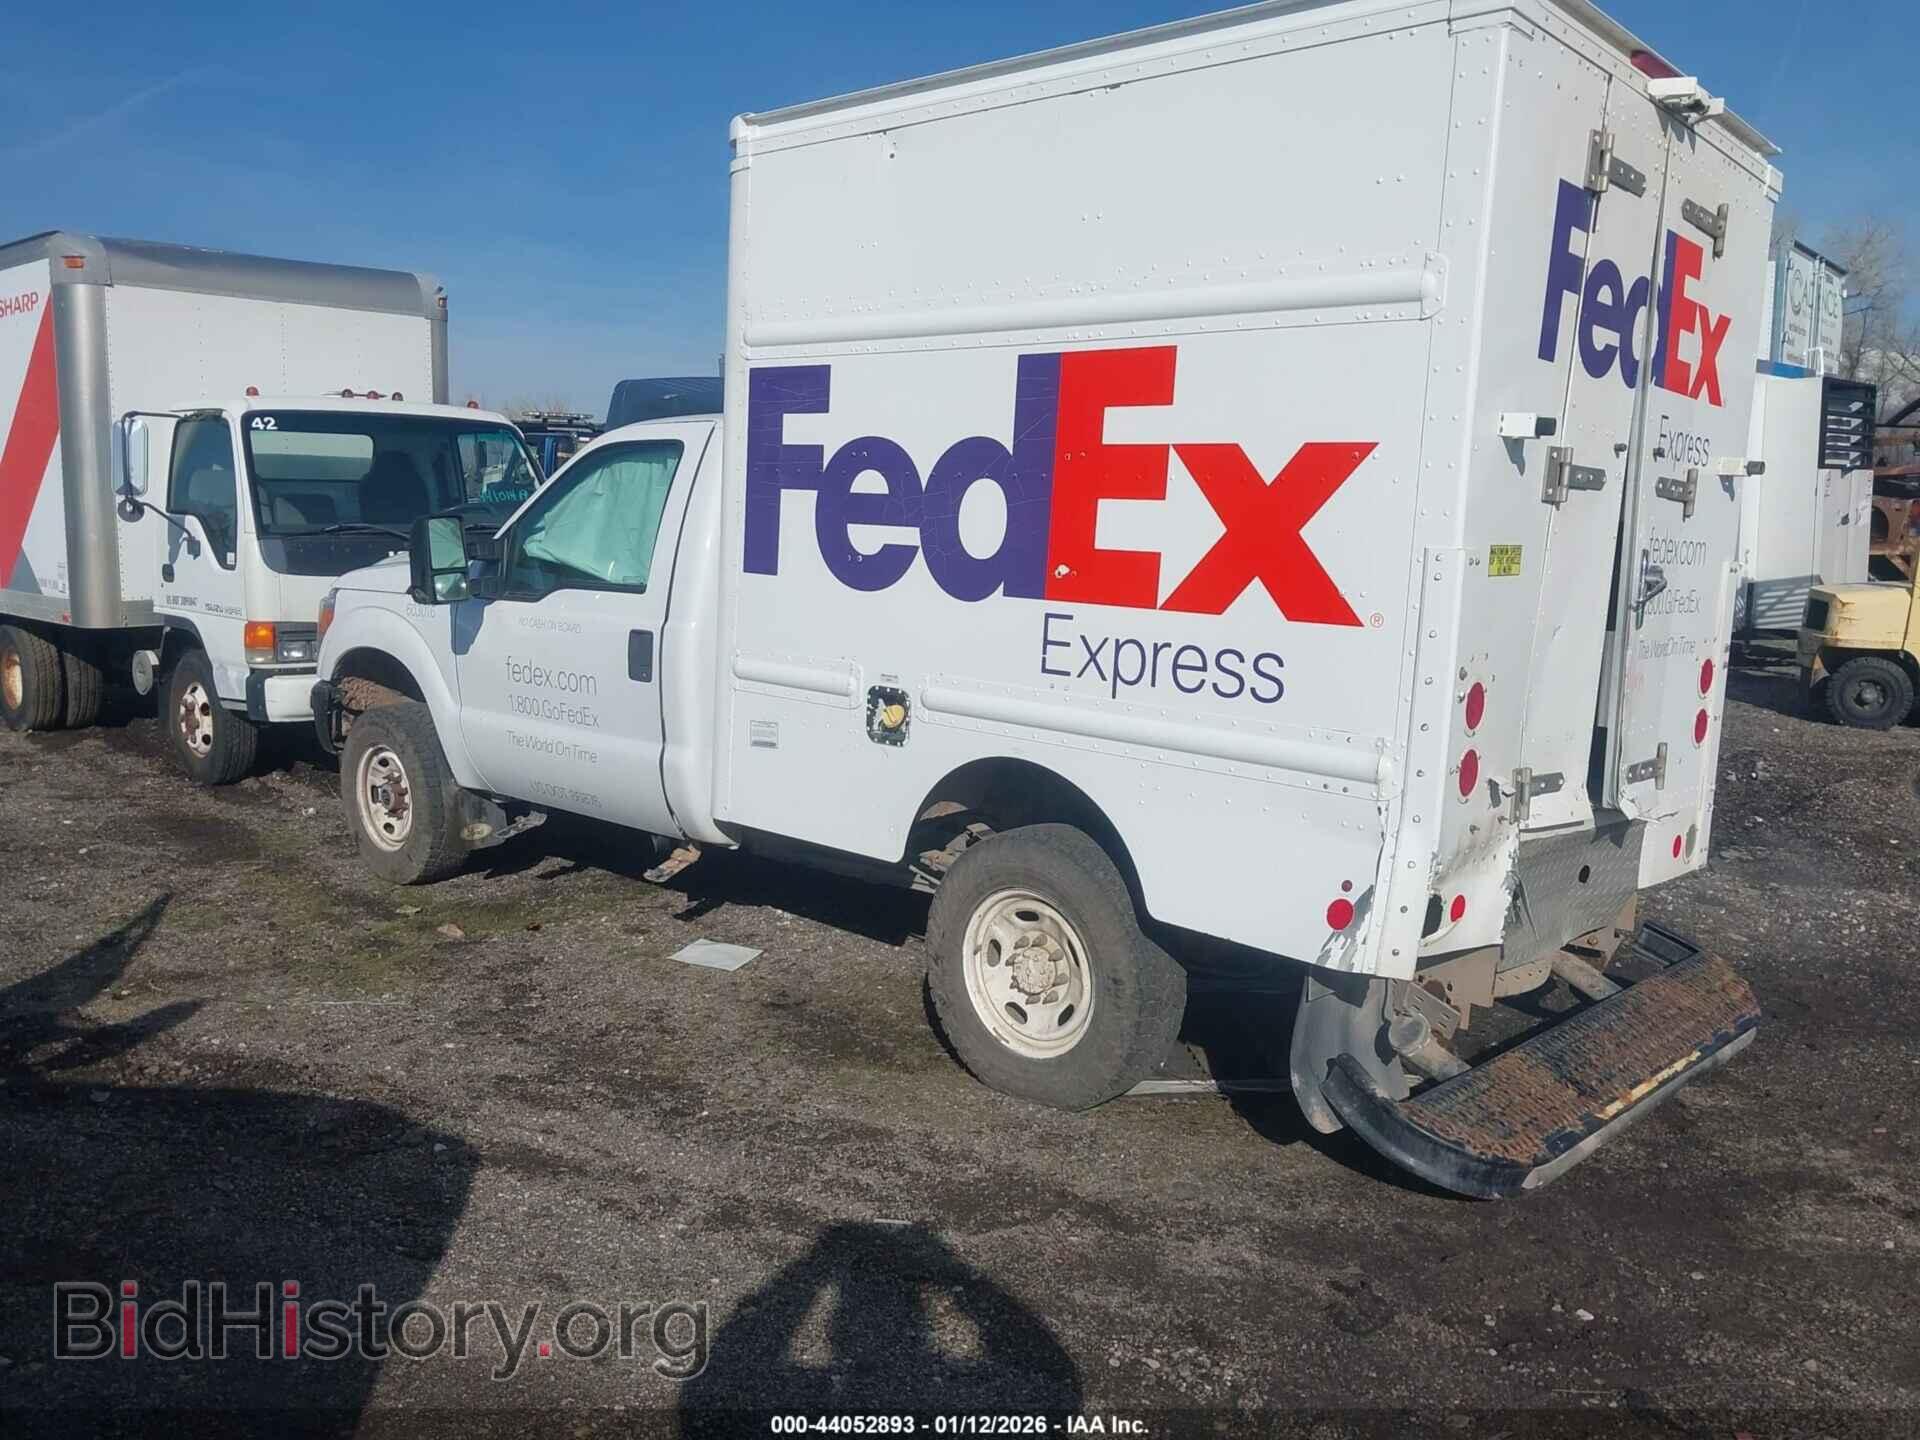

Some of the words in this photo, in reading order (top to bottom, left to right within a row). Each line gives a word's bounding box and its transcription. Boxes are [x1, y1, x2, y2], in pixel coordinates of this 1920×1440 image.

[1538, 178, 1731, 408] FedEx
[251, 416, 279, 430] 42
[1658, 414, 1710, 473] Express
[743, 345, 1380, 628] FedEx
[505, 655, 597, 696] fedex.com
[1041, 612, 1286, 704] Express
